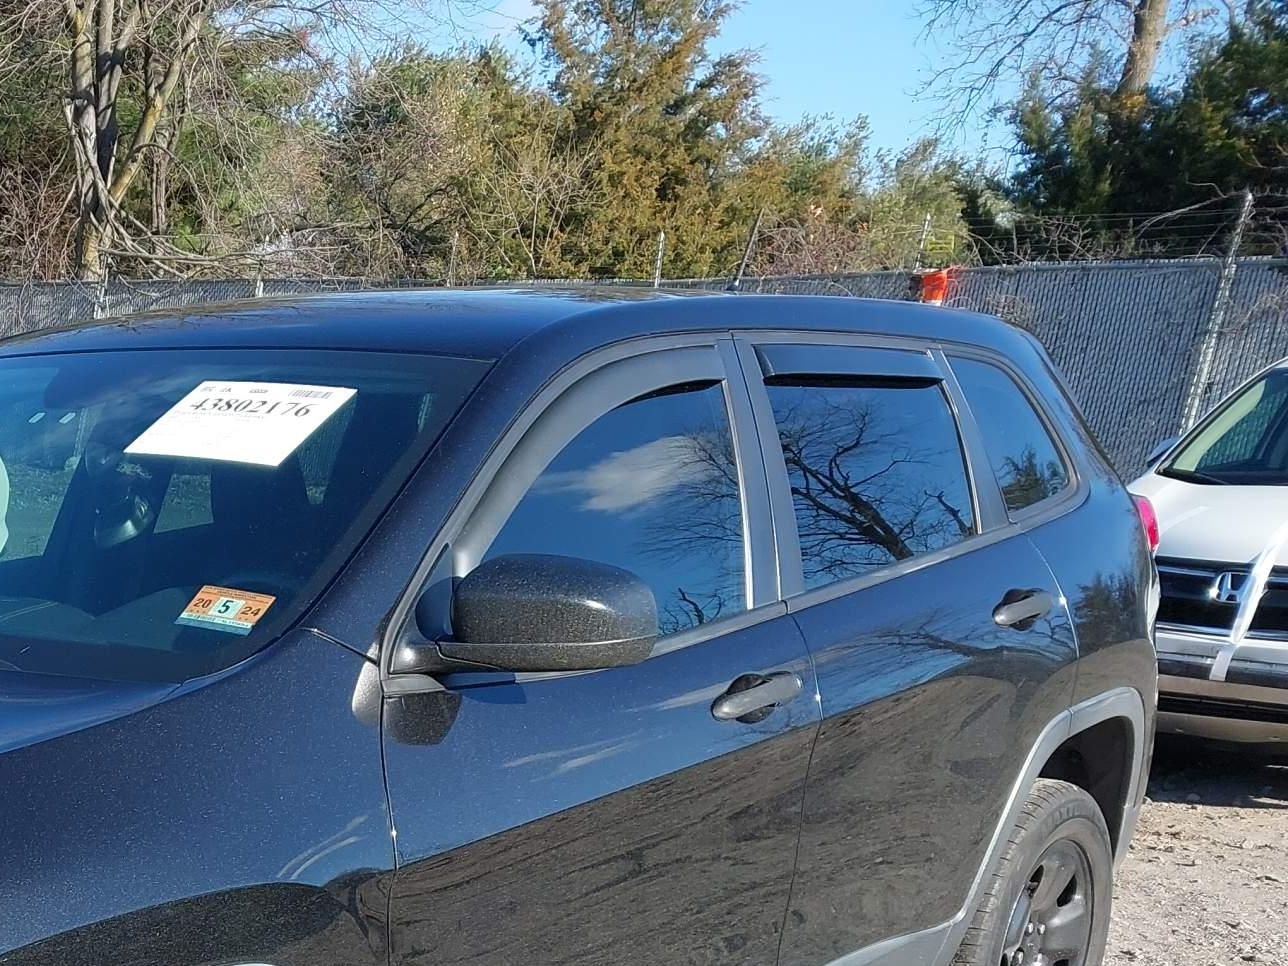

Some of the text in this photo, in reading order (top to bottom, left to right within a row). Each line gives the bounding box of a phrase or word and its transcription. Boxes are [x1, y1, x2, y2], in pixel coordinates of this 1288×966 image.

[188, 397, 322, 418] 43802176
[193, 597, 262, 617] 20 5 24
